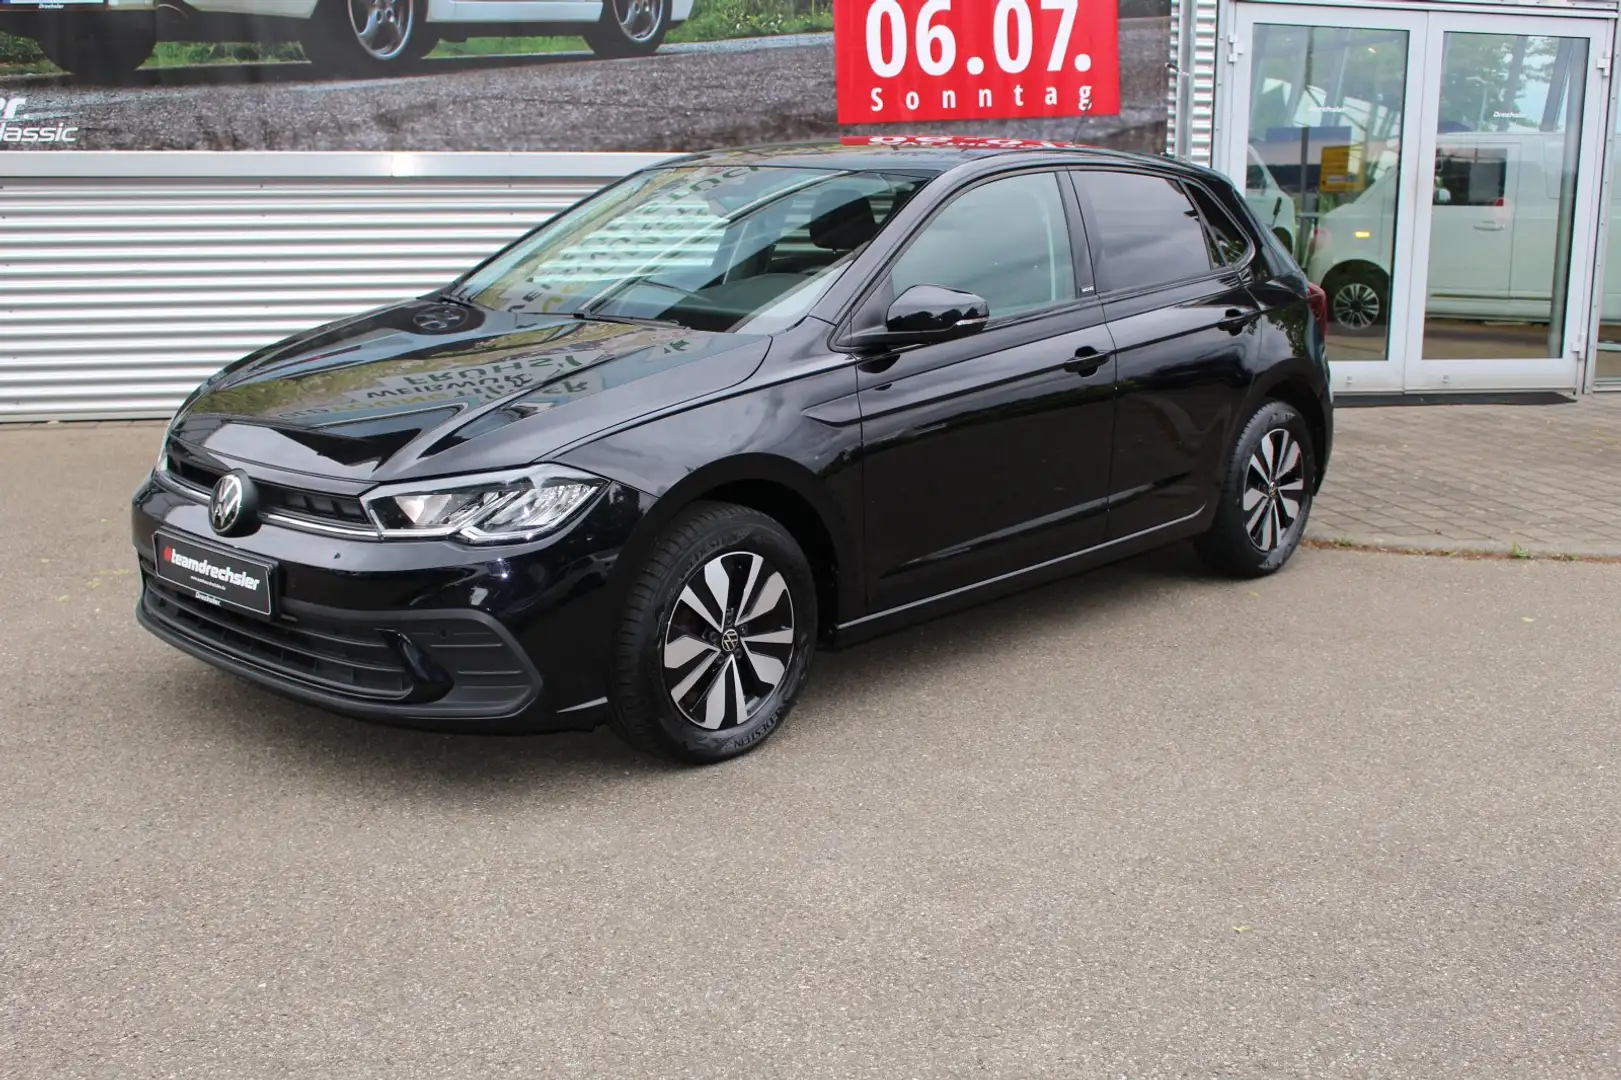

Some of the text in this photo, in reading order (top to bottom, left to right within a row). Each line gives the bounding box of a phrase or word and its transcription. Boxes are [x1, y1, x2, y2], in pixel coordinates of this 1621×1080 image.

[866, 0, 1092, 78] 06.07.
[870, 84, 1093, 112] Sonntag
[0, 122, 79, 142] lassic
[163, 546, 261, 591] #teamdrechsler
